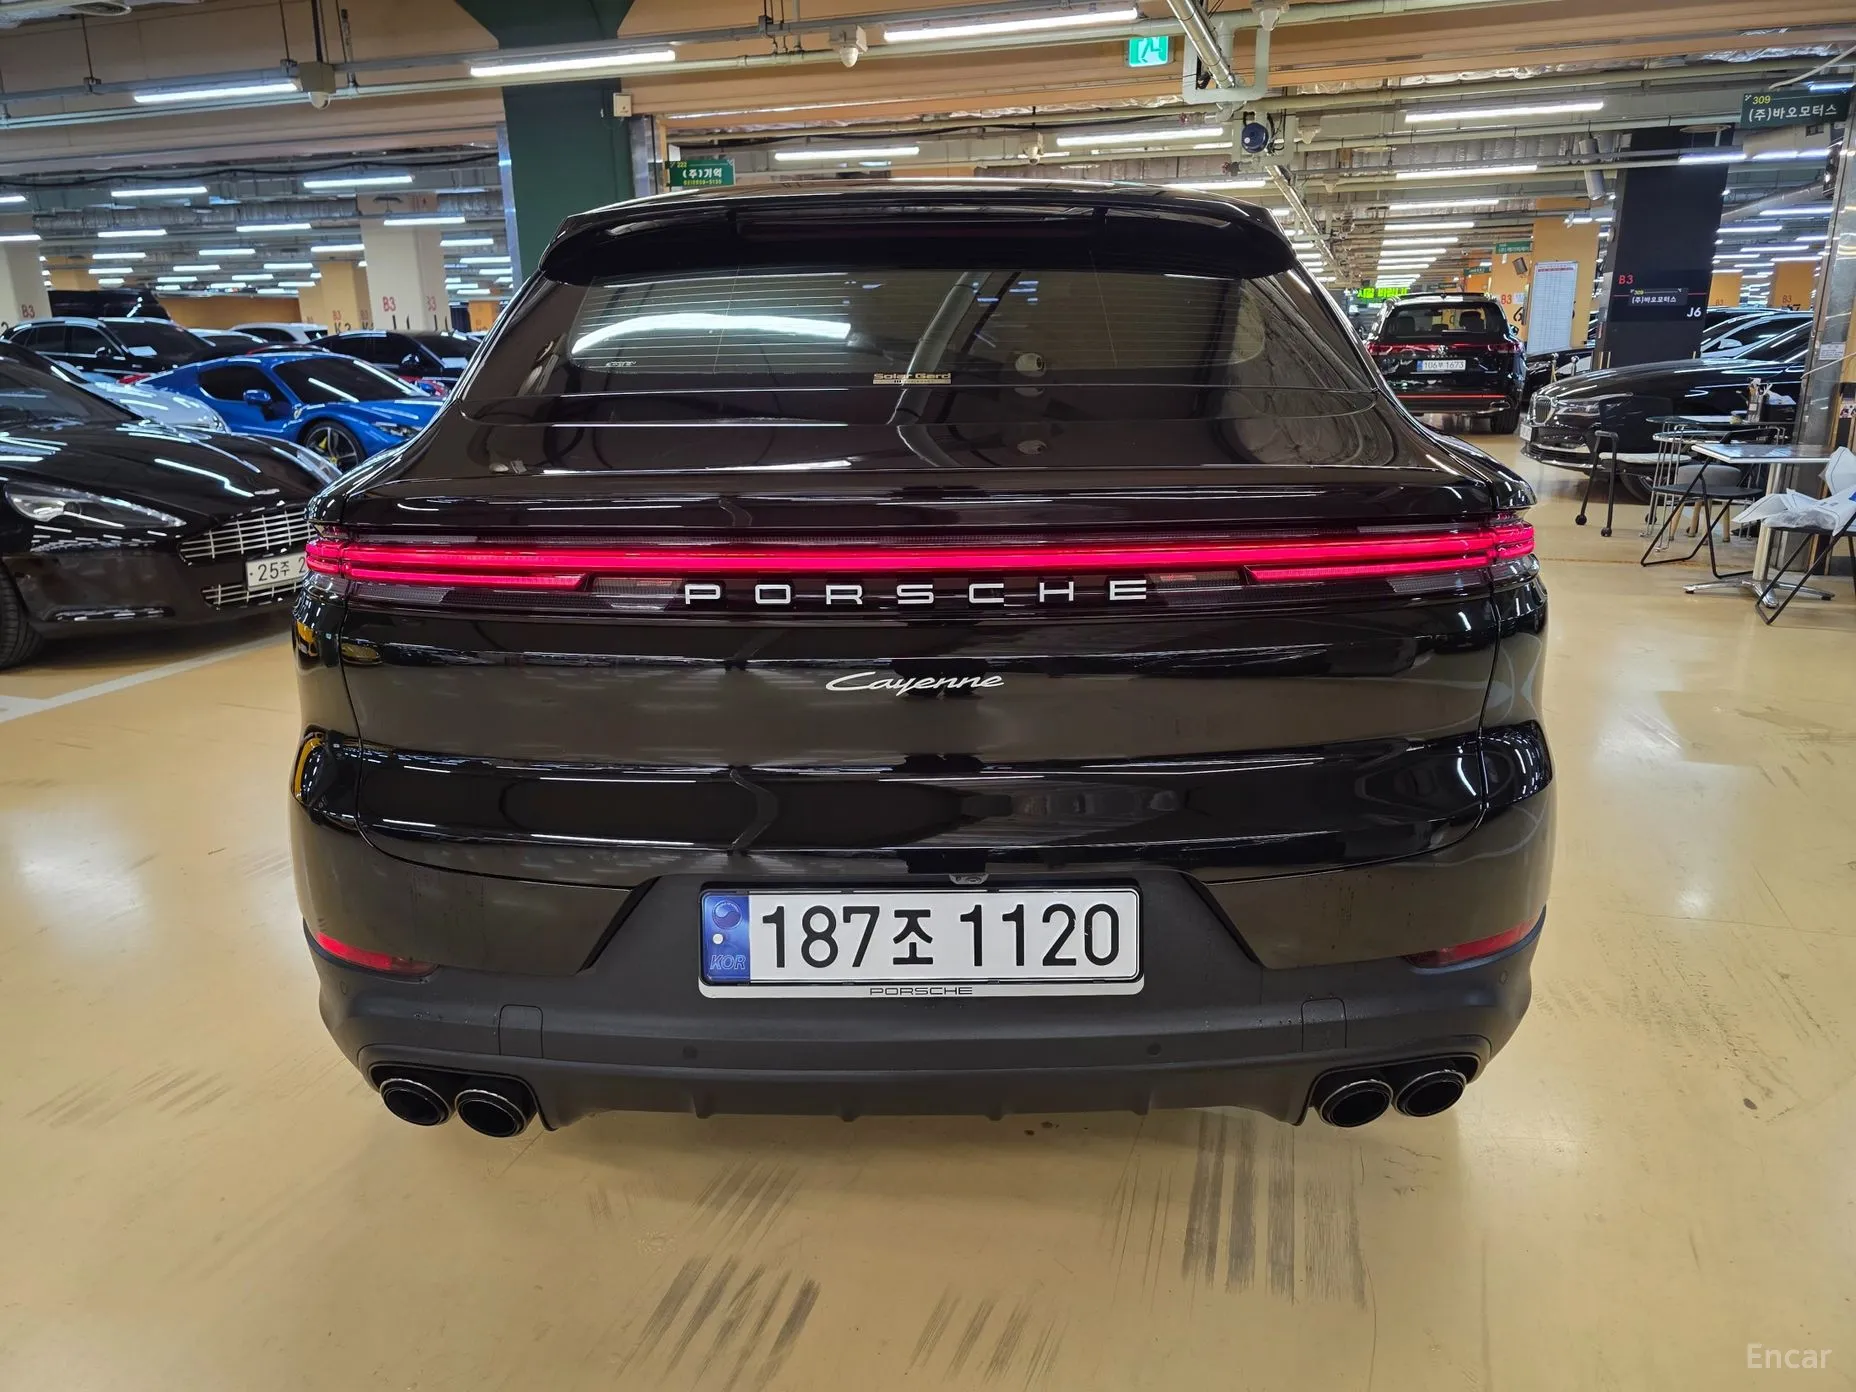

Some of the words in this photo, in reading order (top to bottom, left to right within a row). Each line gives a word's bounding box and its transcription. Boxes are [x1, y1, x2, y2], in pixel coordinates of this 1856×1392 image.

[1752, 95, 1771, 105] 309
[1748, 104, 1838, 122] (주)바오모터스
[1618, 275, 1634, 285] B3
[382, 296, 396, 312] B3
[1631, 296, 1677, 304] (주)바오모터스
[21, 303, 35, 318] B3
[1686, 306, 1702, 318] J6
[257, 561, 291, 582] 25주
[684, 579, 1148, 605] PORSCHE
[825, 670, 1005, 697] Cayenne
[762, 905, 934, 969] 187조
[959, 903, 1120, 967] 1120
[709, 954, 747, 970] KOR
[869, 986, 973, 996] PORSCHE
